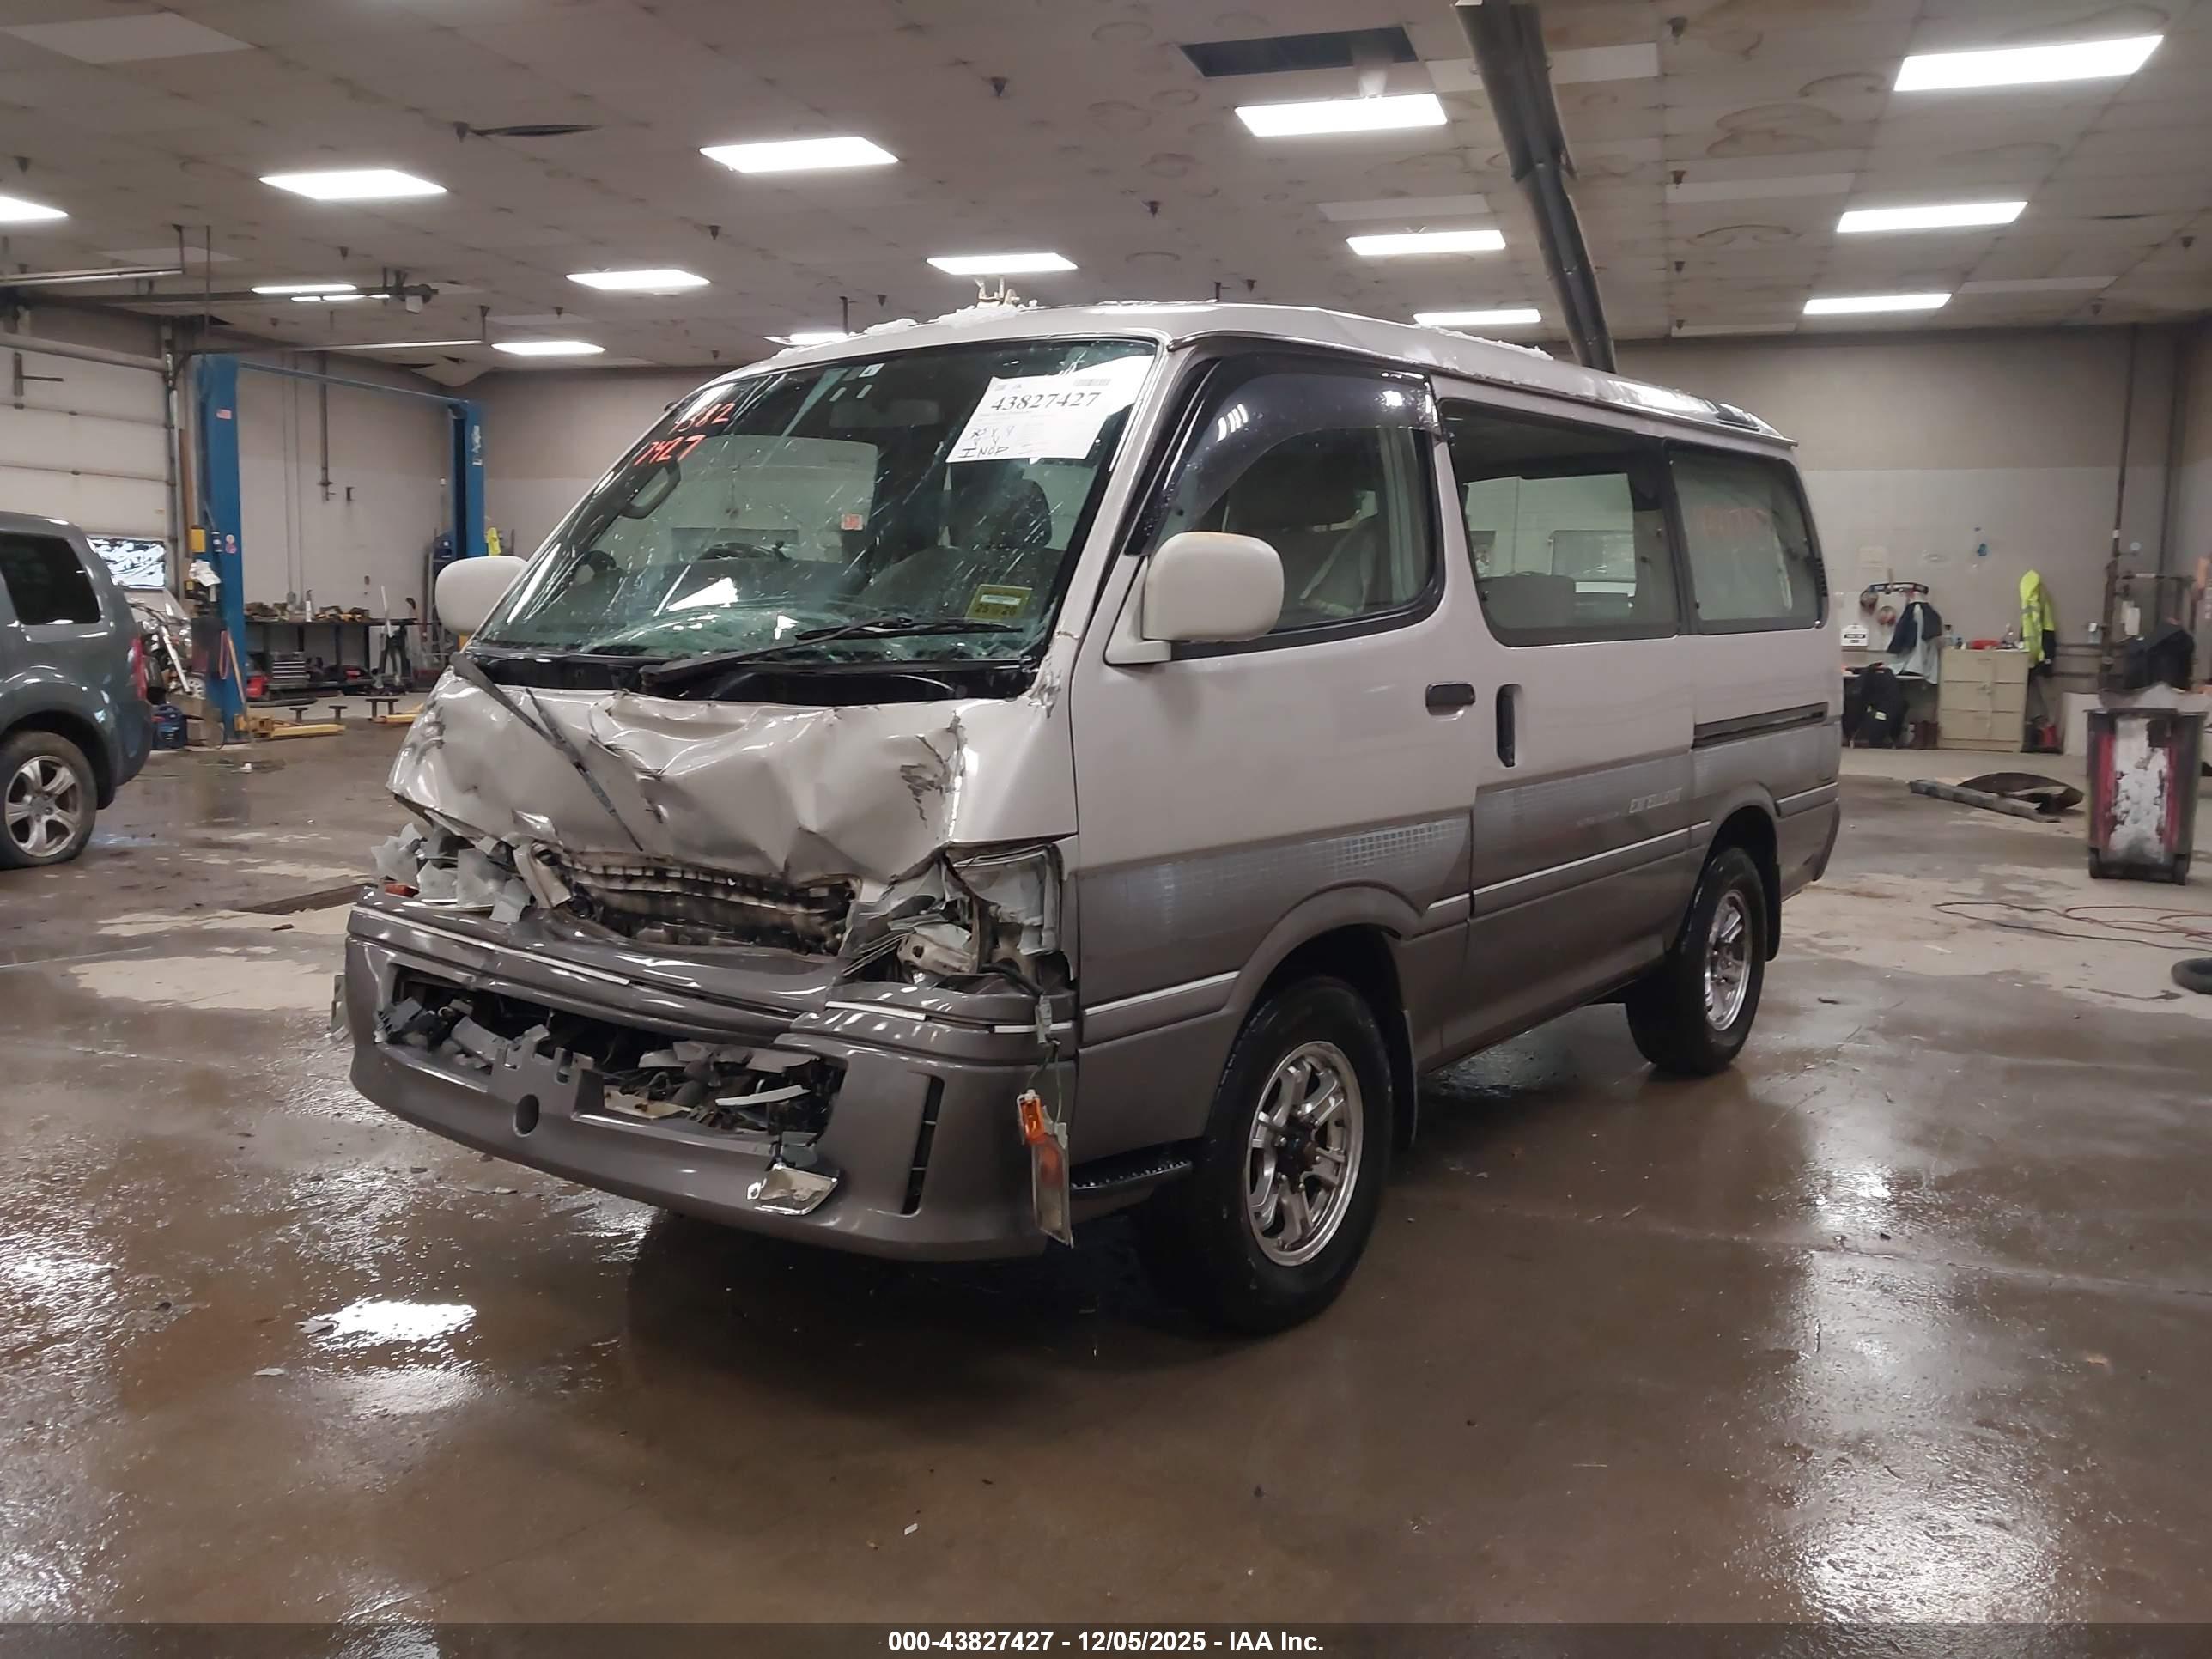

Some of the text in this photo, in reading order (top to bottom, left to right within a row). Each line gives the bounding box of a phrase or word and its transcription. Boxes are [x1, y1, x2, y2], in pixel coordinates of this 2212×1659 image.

[990, 392, 1102, 411] 43827427
[634, 434, 707, 466] 7427
[957, 446, 1010, 458] INOP
